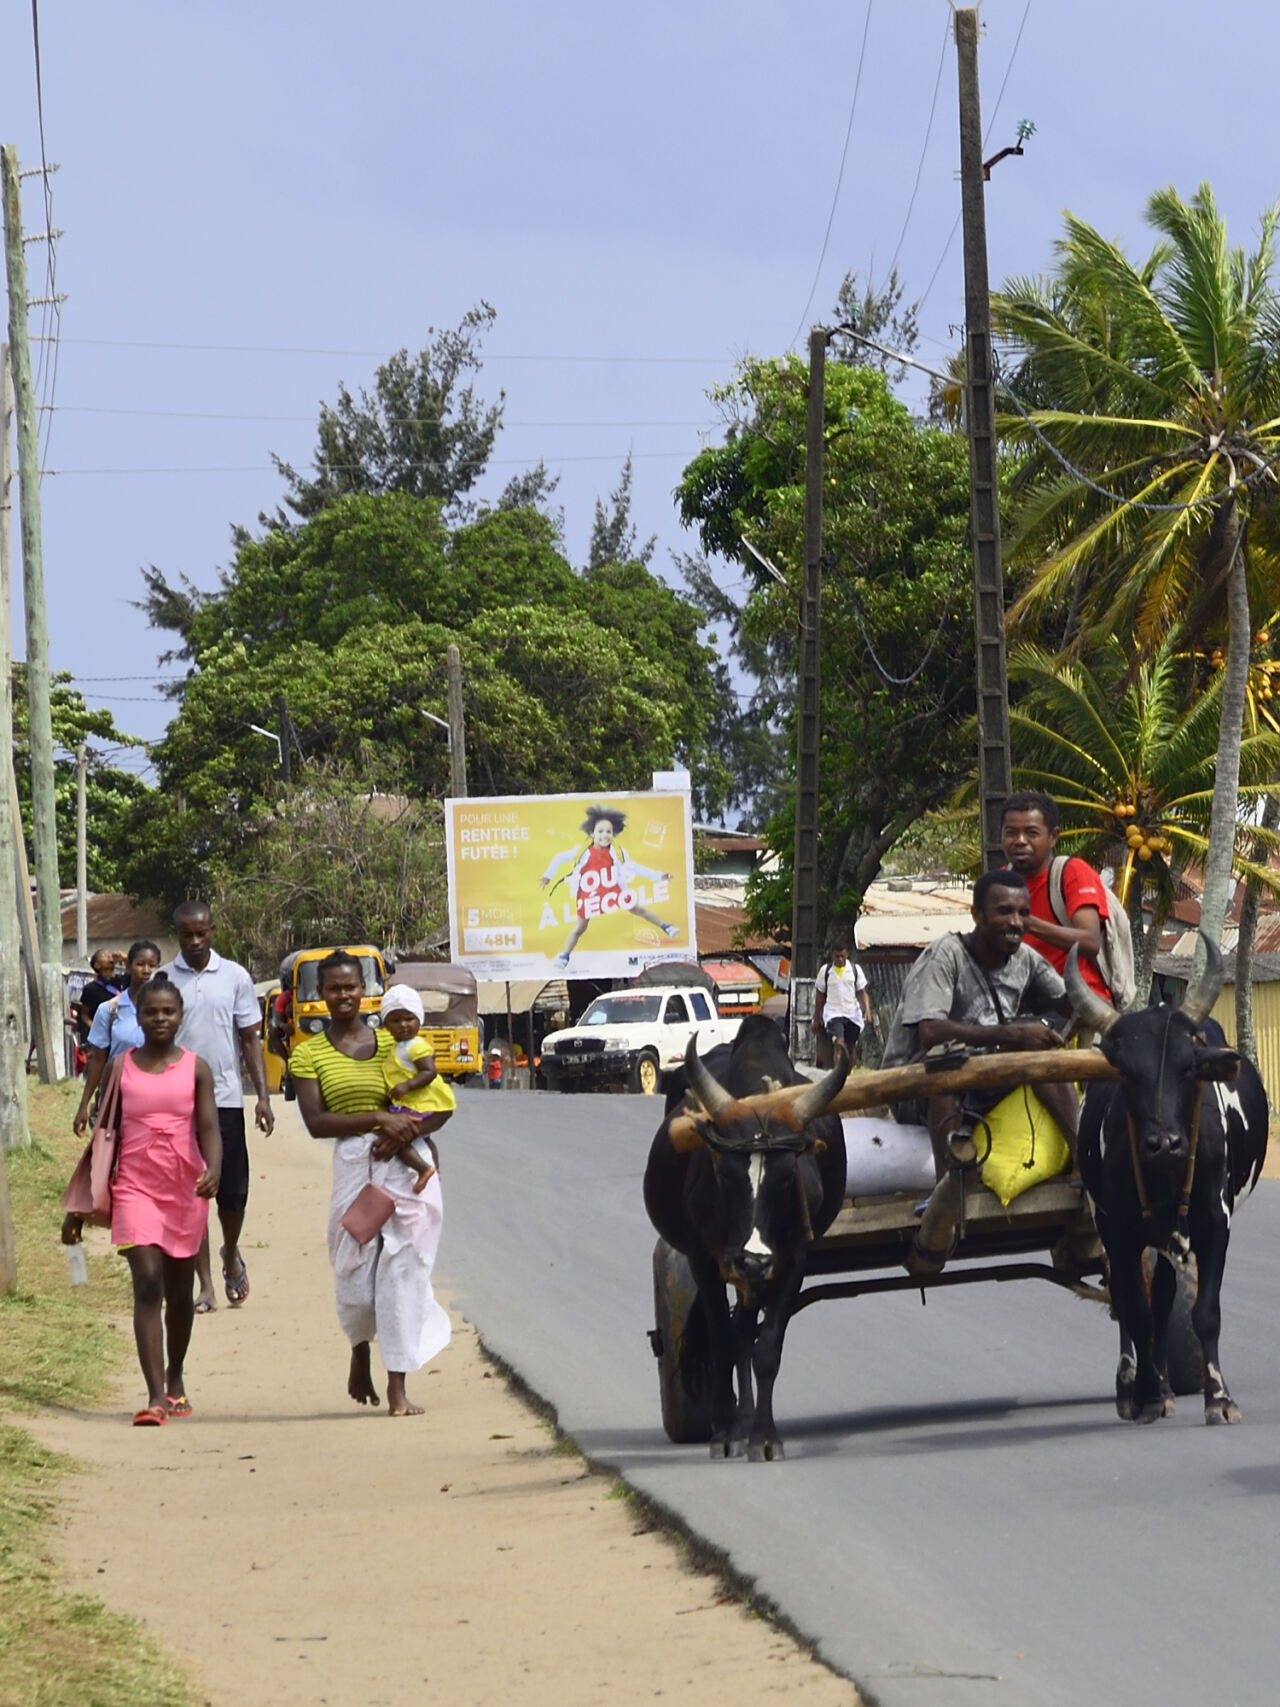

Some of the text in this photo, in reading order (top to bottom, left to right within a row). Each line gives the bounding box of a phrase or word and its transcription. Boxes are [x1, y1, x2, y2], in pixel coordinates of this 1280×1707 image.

[460, 811, 518, 825] POUR UNE
[461, 824, 529, 843] RENTRÉE
[461, 843, 518, 860] FUTÉE !
[467, 908, 480, 928] 5
[484, 933, 516, 947] 48H
